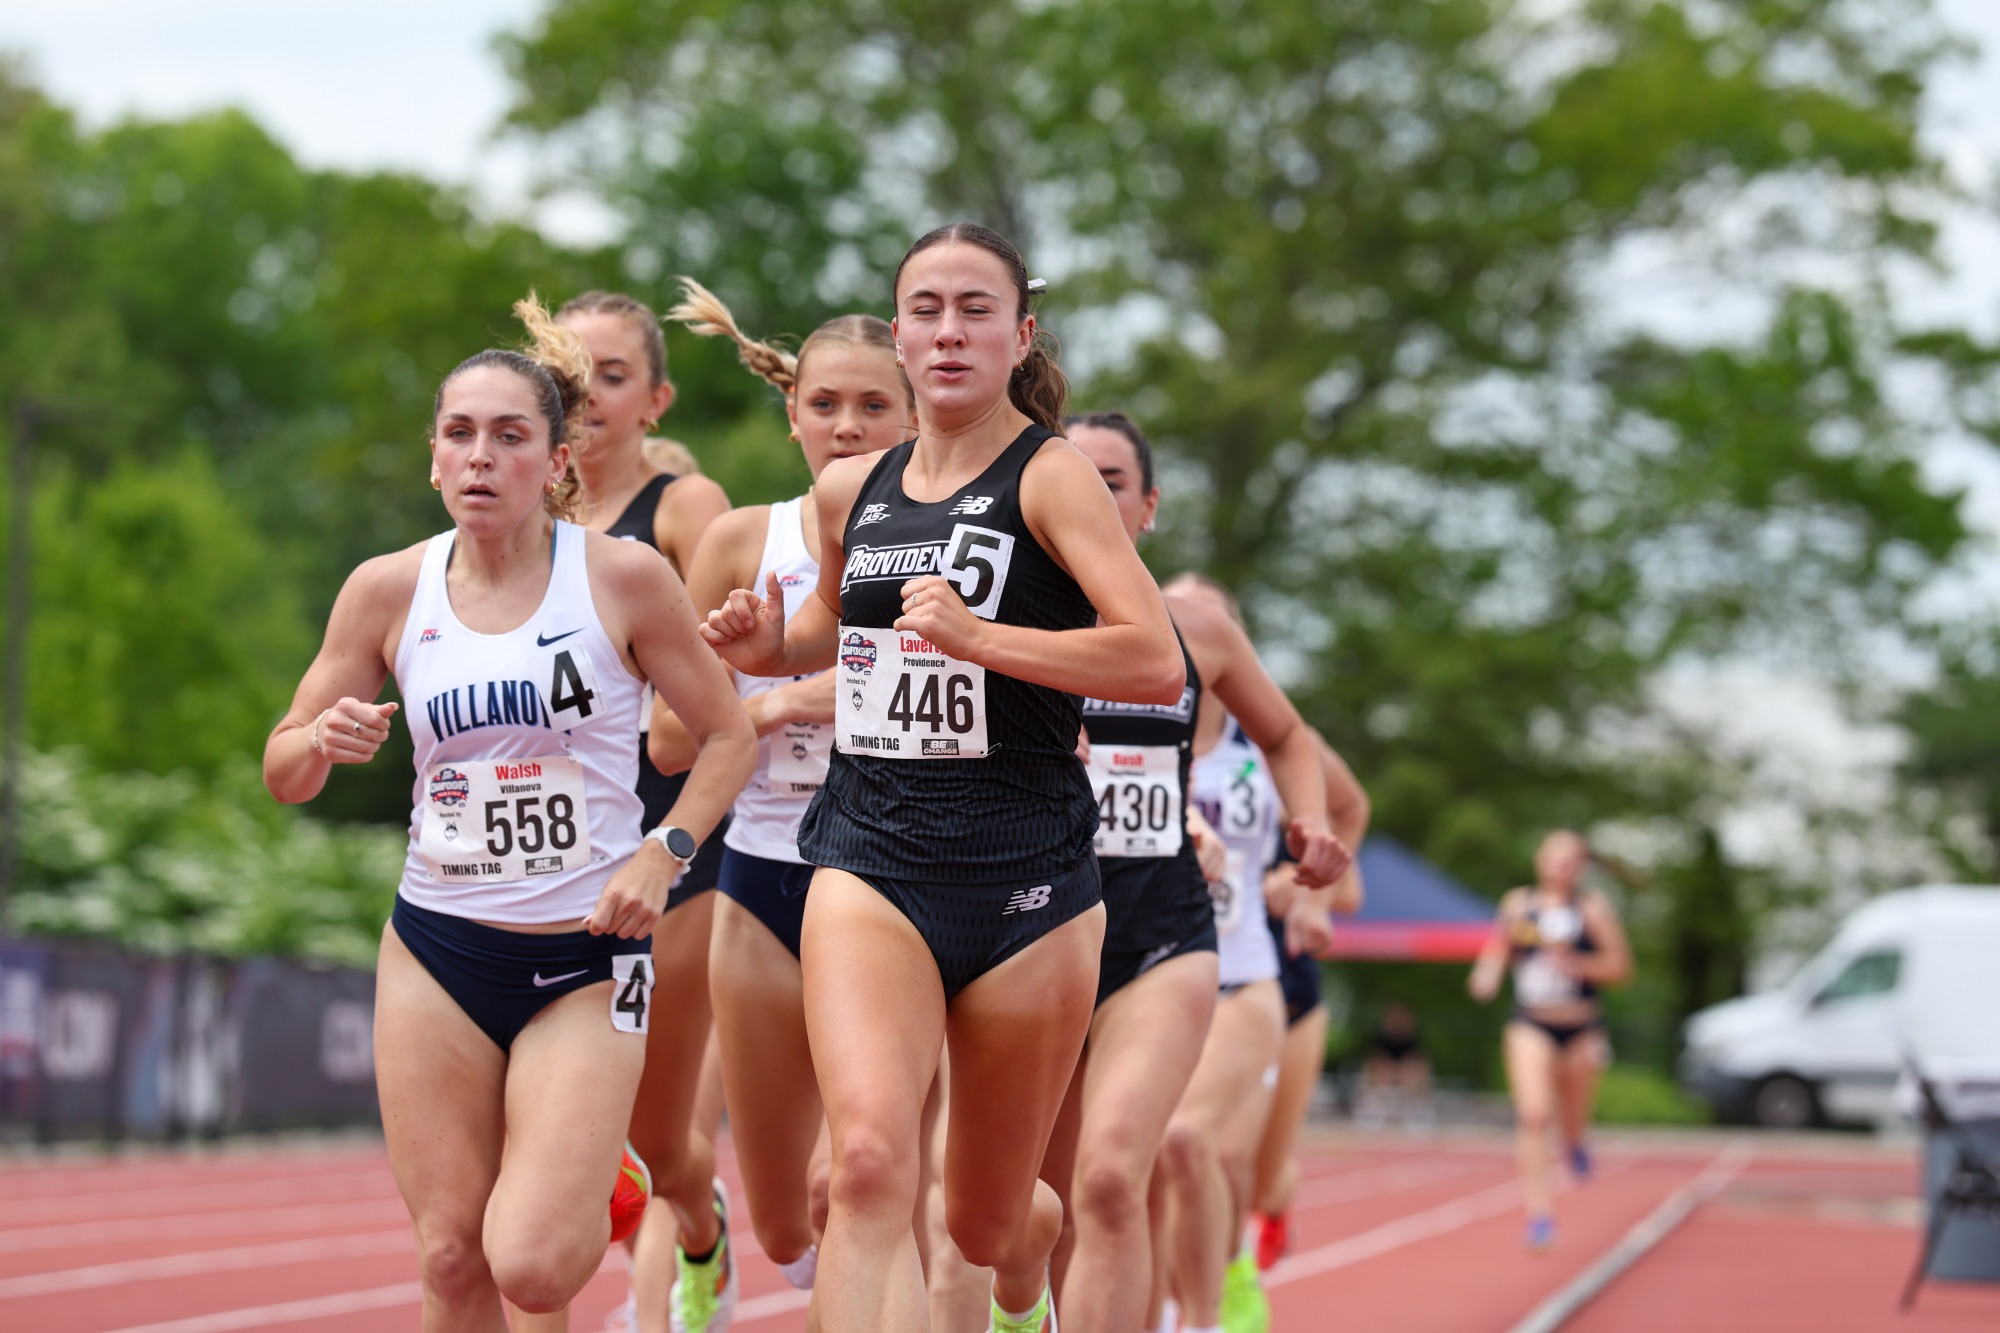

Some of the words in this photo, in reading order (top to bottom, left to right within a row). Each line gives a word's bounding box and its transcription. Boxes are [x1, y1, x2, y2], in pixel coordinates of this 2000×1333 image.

[857, 513, 891, 525] EAST
[864, 503, 889, 514] BIG
[841, 545, 947, 589] PROVIDEN
[947, 531, 1001, 607] 5
[900, 636, 945, 655] Laver
[904, 656, 946, 668] Providence
[551, 650, 594, 719] 4
[427, 680, 571, 743] VILLANO
[888, 673, 974, 734] 446
[851, 734, 880, 749] TIMING
[881, 737, 900, 751] TAG
[495, 763, 542, 780] Walsh
[500, 783, 541, 794] Villanova
[790, 782, 821, 793] TIMIN
[1231, 777, 1255, 828] 3
[1100, 783, 1168, 832] 430
[485, 794, 577, 857] 558
[441, 864, 479, 876] TIMING
[481, 863, 502, 875] TAG
[616, 960, 646, 1027] 4
